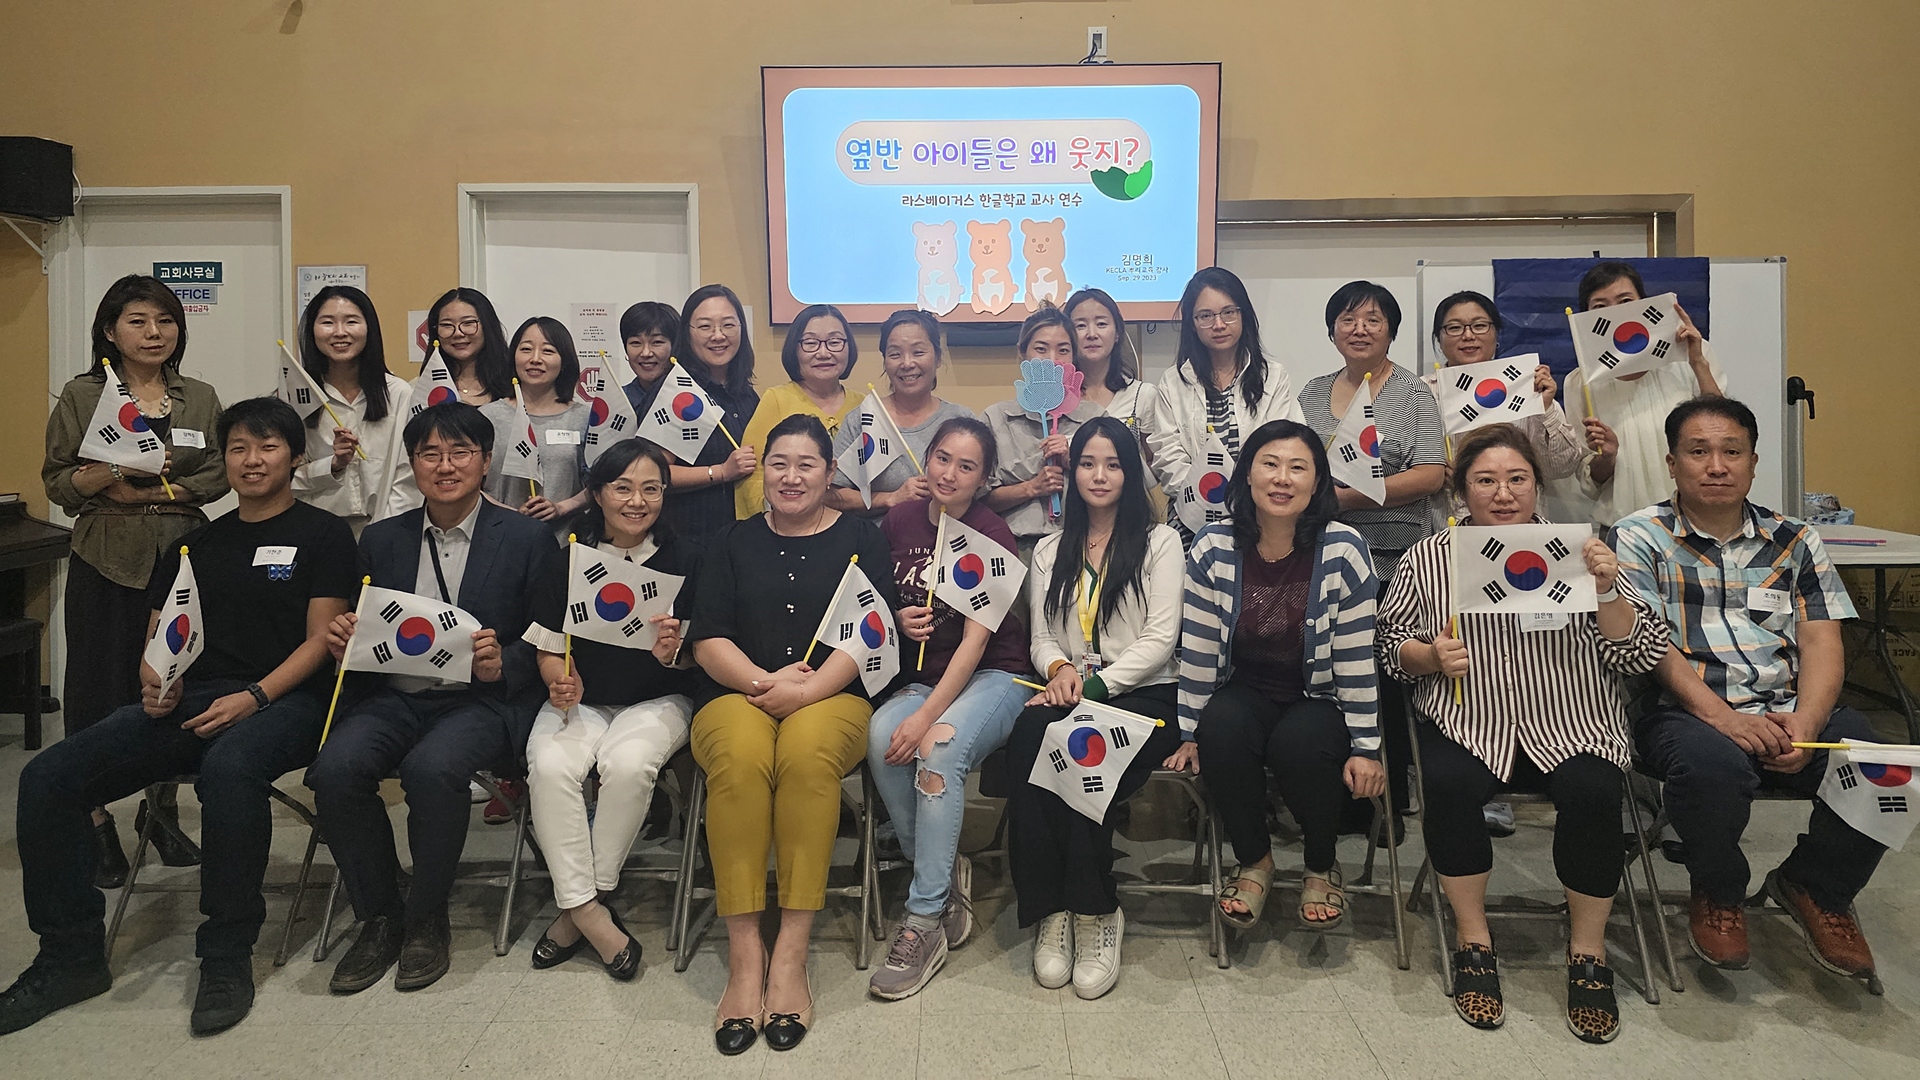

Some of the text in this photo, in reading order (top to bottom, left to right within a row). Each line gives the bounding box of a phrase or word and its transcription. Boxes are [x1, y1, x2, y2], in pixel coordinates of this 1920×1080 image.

[846, 136, 1140, 171] 옆반 아이들은 왜 웃지?
[901, 192, 1083, 208] 라스베이거스 한글학교 교사 연수
[1121, 254, 1153, 266] 김명희
[160, 266, 215, 279] 교회사무실
[174, 289, 210, 299] FFICE
